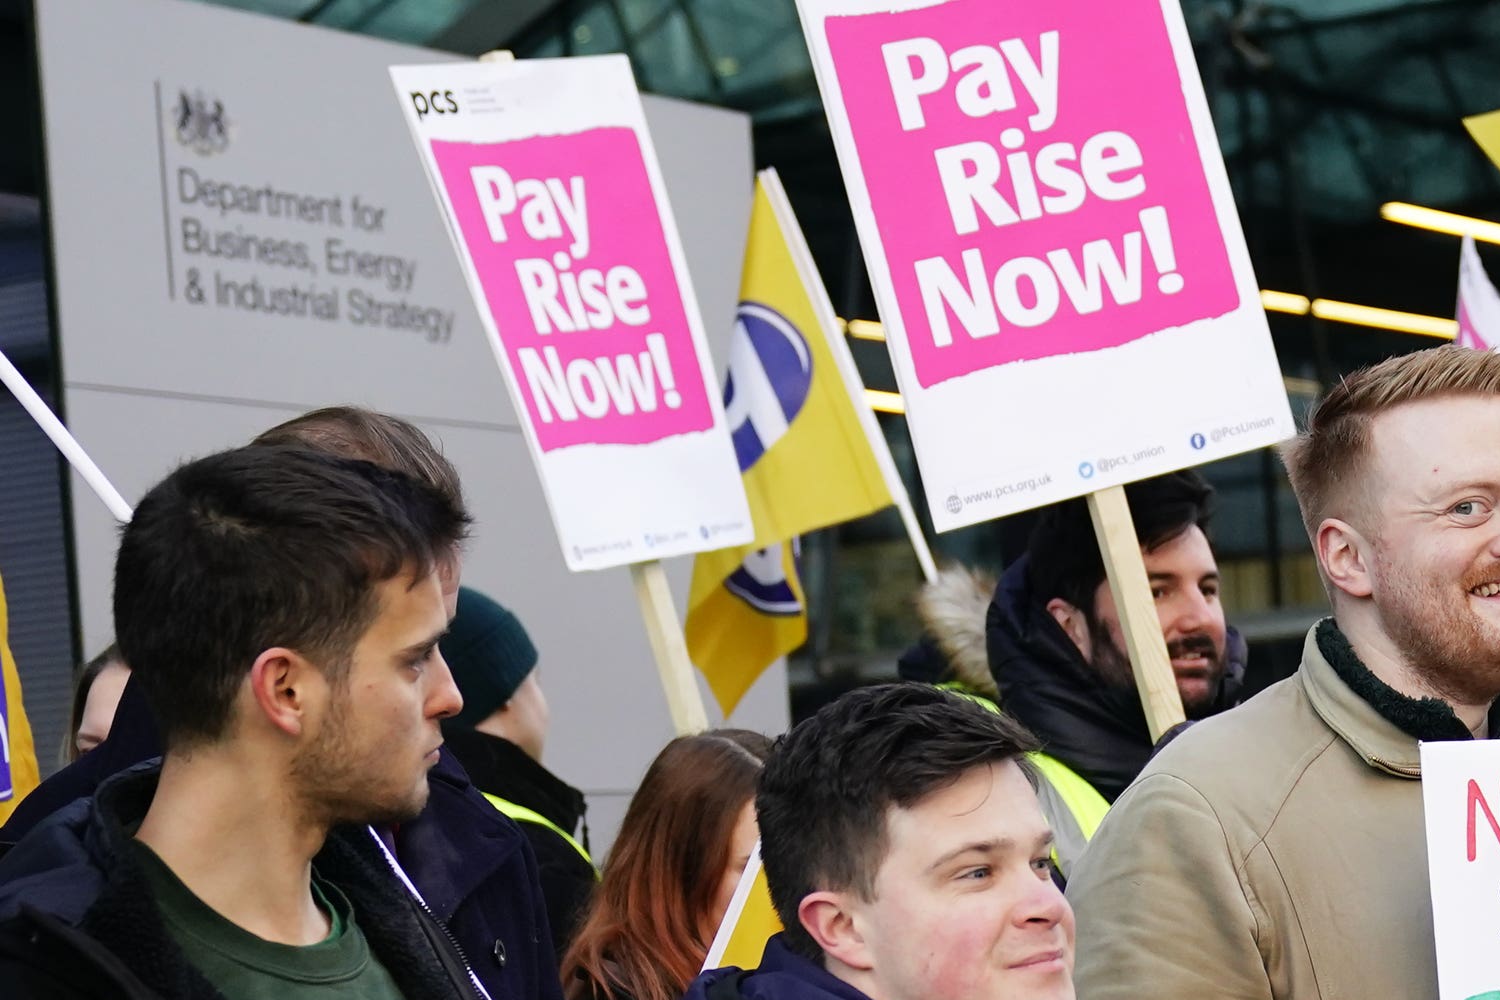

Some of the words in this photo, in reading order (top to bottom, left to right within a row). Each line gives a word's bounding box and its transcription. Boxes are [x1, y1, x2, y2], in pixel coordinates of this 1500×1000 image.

[410, 89, 458, 121] pcs
[881, 30, 1059, 132] Pay
[177, 166, 344, 228] Department
[351, 195, 386, 232] for
[469, 165, 590, 259] Pay
[934, 127, 1146, 236] Rise
[181, 216, 317, 275] Business,
[324, 237, 418, 293] Energy
[514, 251, 651, 335] Rise
[913, 205, 1184, 348] Now!
[184, 266, 205, 305] &
[214, 271, 339, 322] Industrial
[347, 287, 456, 344] Strategy
[517, 332, 682, 424] Now!
[964, 474, 1052, 506] www.pcs.org.uk
[1097, 444, 1166, 473] @pcs_union
[1210, 415, 1275, 443] @PcsUnion
